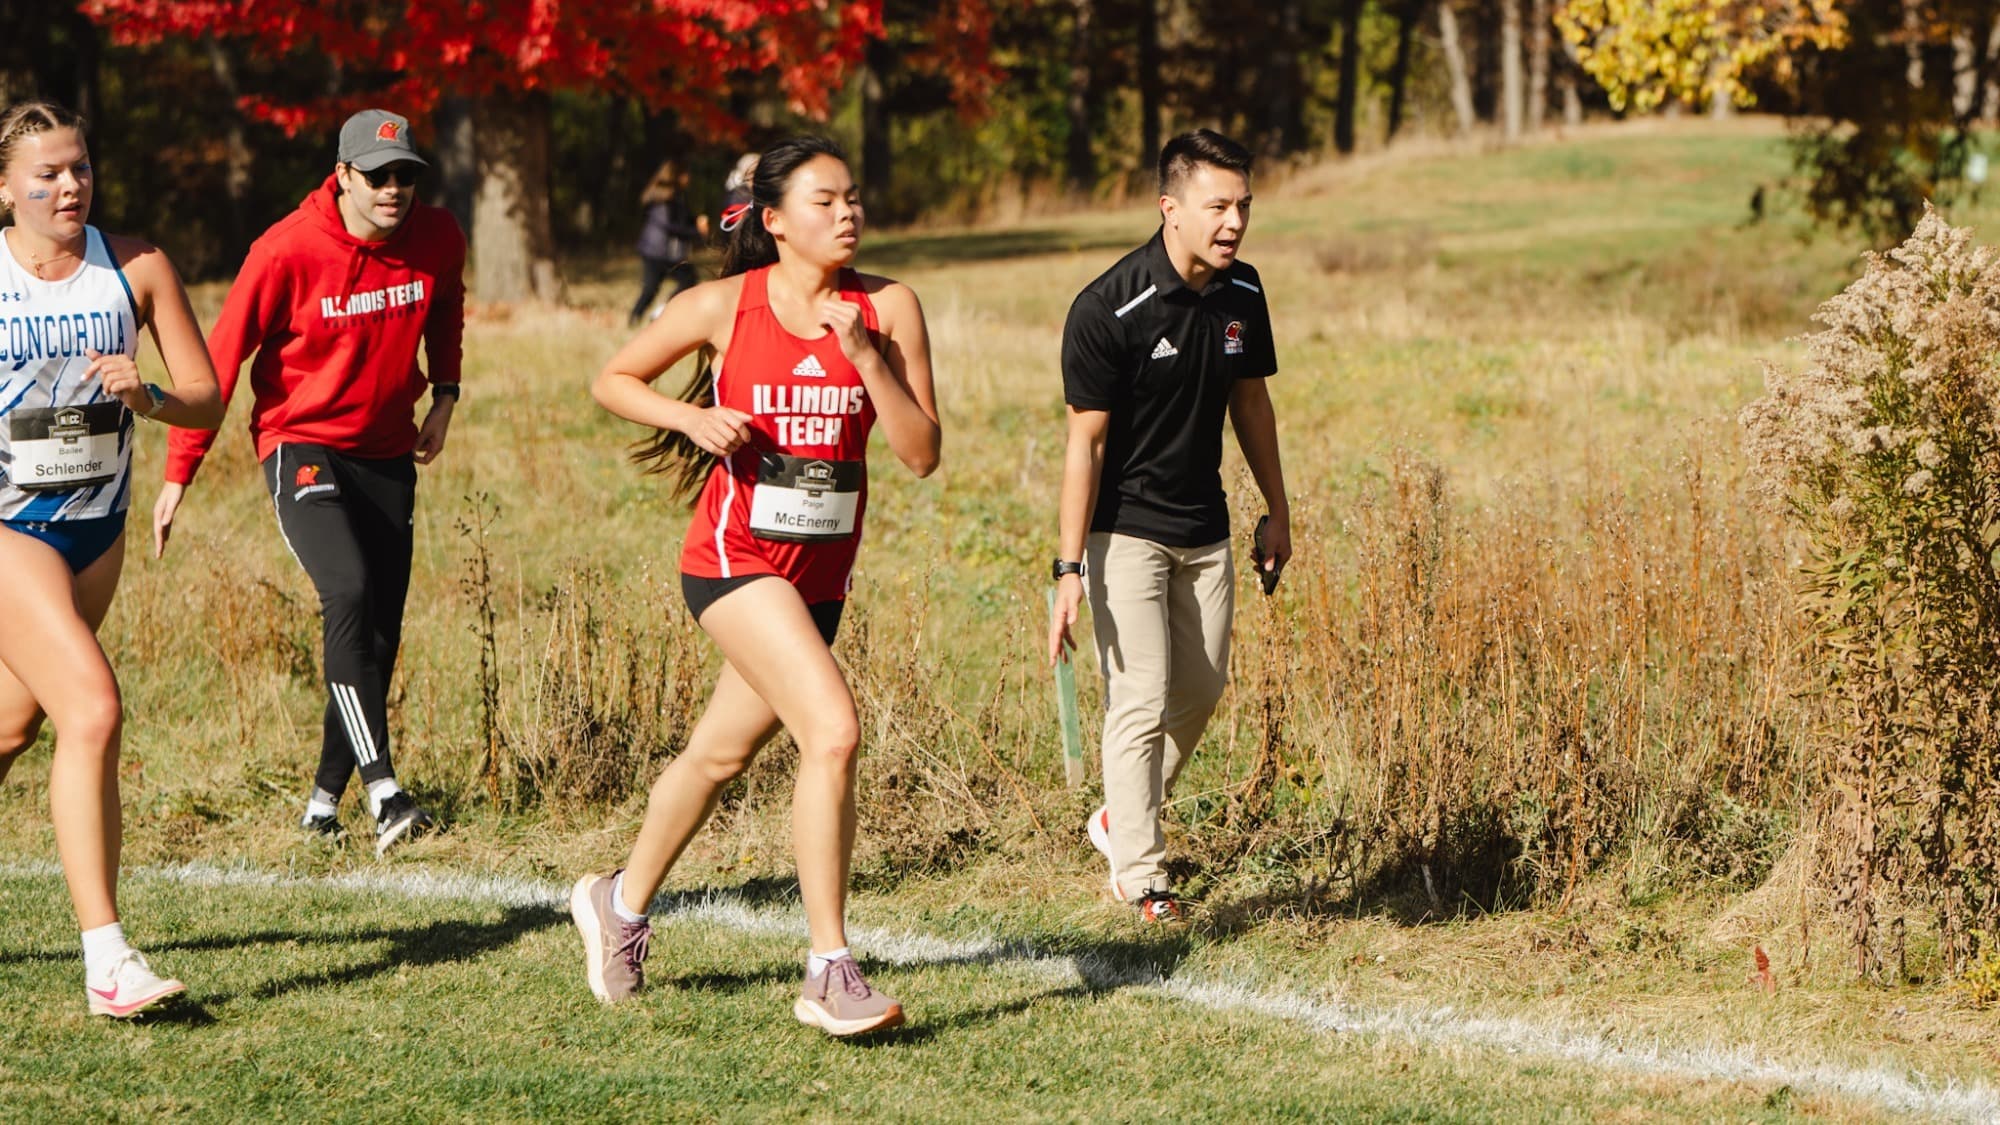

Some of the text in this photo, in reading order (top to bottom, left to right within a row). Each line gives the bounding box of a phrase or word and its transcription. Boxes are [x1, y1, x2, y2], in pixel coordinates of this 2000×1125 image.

[386, 280, 424, 308] TECH
[753, 384, 864, 415] ILLINOIS
[774, 415, 842, 446] TECH
[58, 446, 83, 455] Bailee
[35, 460, 102, 477] Schlender
[802, 499, 825, 510] Paige
[774, 511, 841, 530] McEnerny
